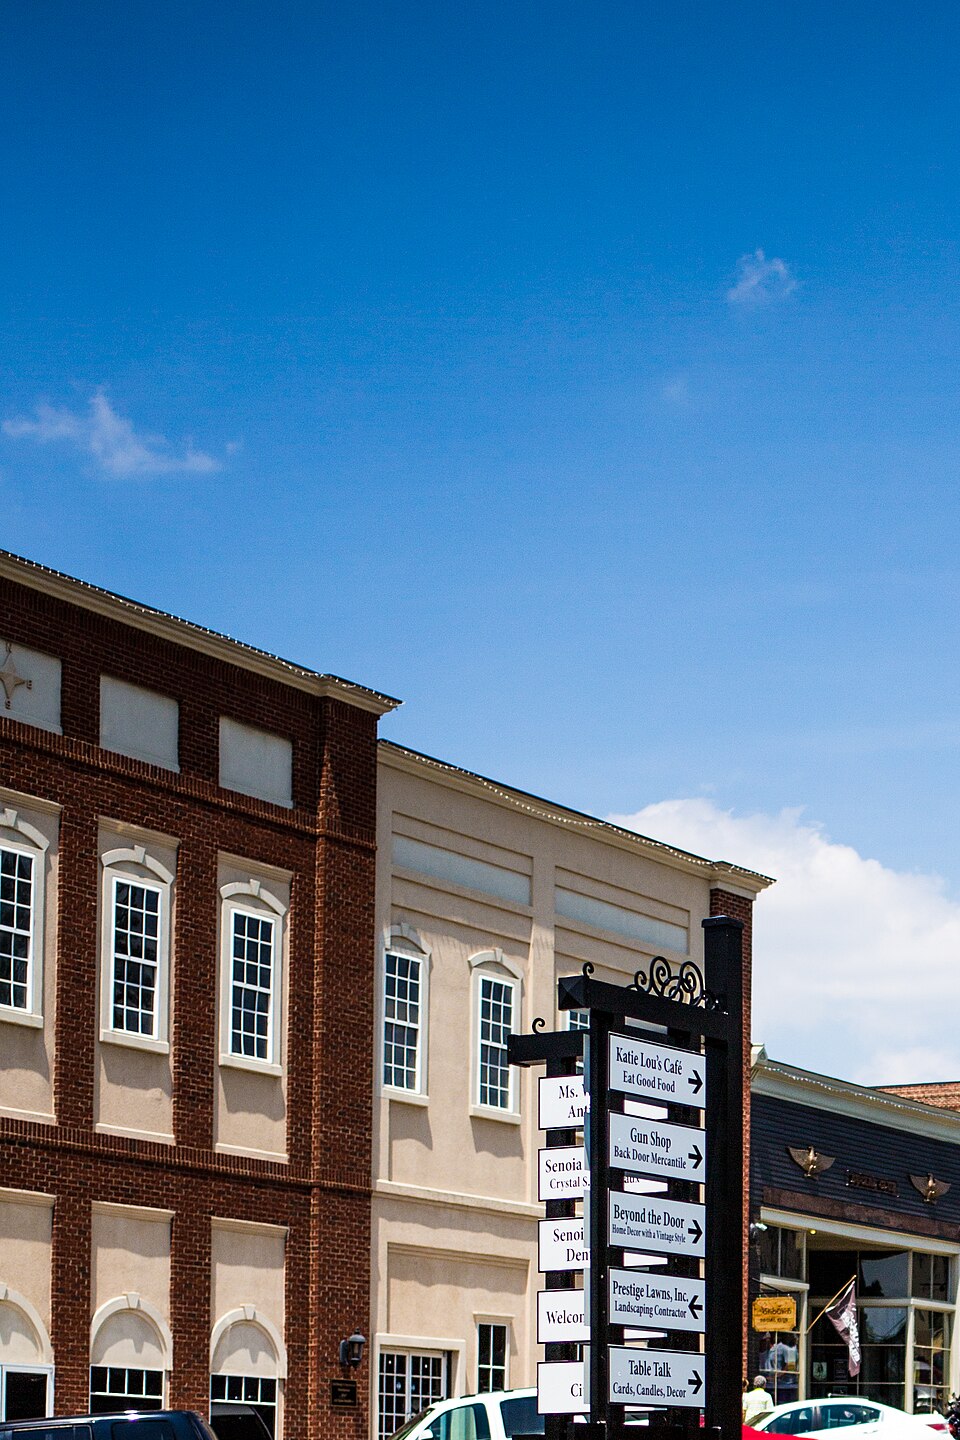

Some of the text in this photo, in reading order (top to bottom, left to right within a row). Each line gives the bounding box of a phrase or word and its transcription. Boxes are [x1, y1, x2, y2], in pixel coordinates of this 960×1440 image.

[616, 1047, 683, 1075] Katie Lou's Café
[559, 1085, 578, 1099] Ms.
[623, 1071, 676, 1093] Eat Good Food
[630, 1127, 672, 1153] Gun Shop
[545, 1158, 582, 1173] Senoia
[614, 1145, 687, 1169] Back Door Mercantile
[550, 1176, 590, 1192] Crystal S.
[613, 1204, 685, 1228] Beyond the Door
[612, 1224, 627, 1235] Home
[627, 1226, 642, 1237] Decor
[642, 1228, 652, 1239] with
[656, 1230, 674, 1244] Vintage
[674, 1233, 686, 1245] Style
[612, 1280, 689, 1302] Prestige Lawns, Inc.
[614, 1300, 687, 1318] Landscaping Contractor
[628, 1359, 672, 1378] Table Talk
[612, 1381, 687, 1398] Cards, Candles, Decor
